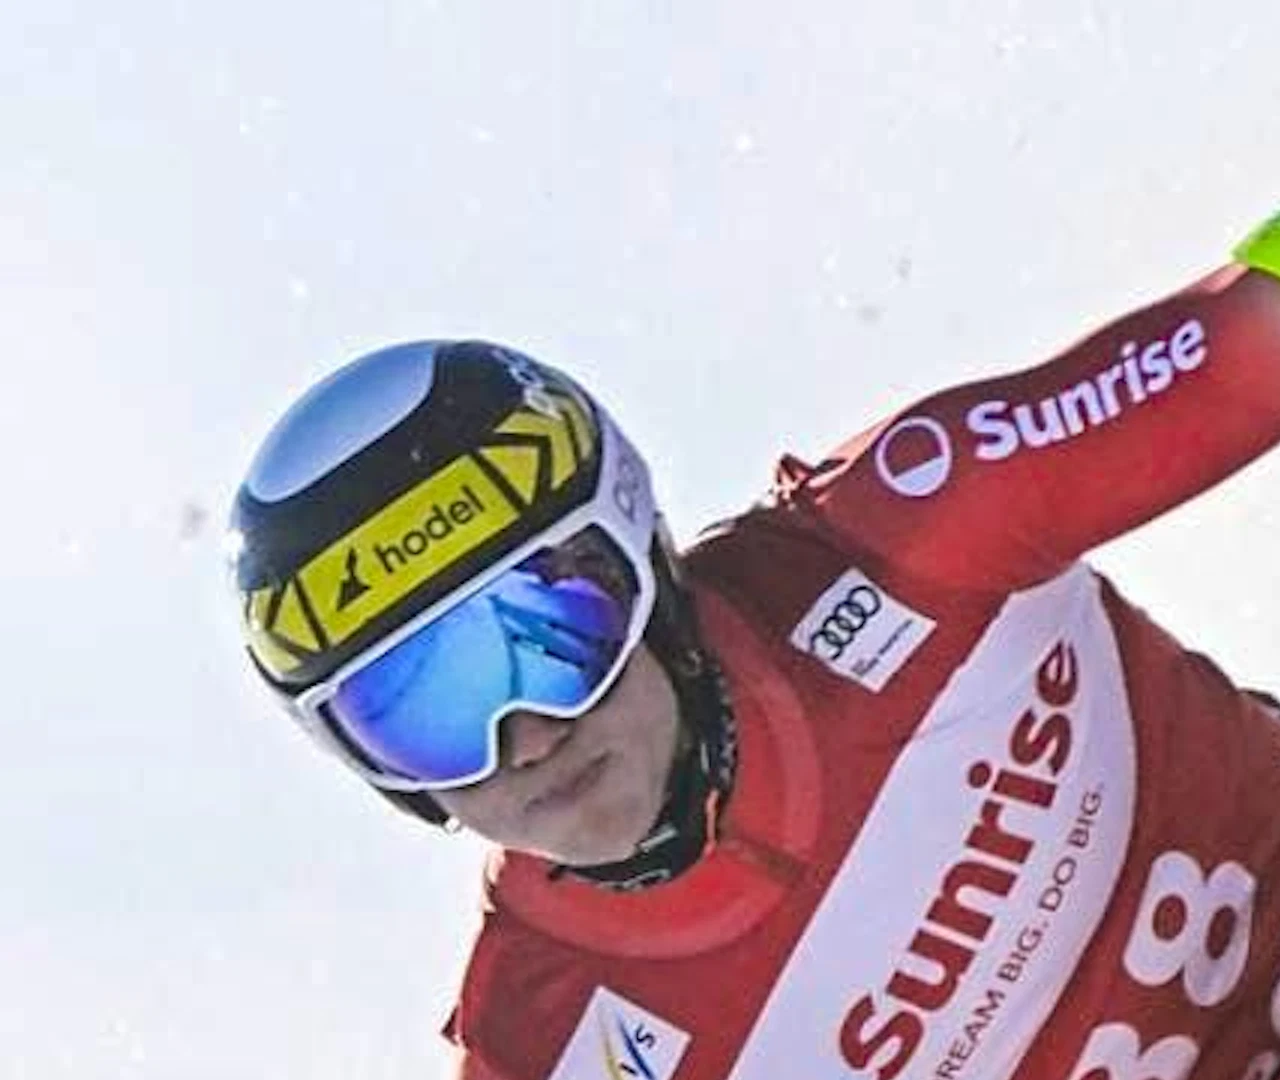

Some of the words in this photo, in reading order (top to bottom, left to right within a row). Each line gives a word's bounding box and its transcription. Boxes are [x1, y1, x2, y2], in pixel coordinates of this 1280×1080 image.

[965, 317, 1207, 461] Sunrise
[375, 485, 487, 575] hodel
[996, 920, 1049, 985] BIG.
[1038, 856, 1078, 913] DO
[1067, 782, 1105, 849] BIG.
